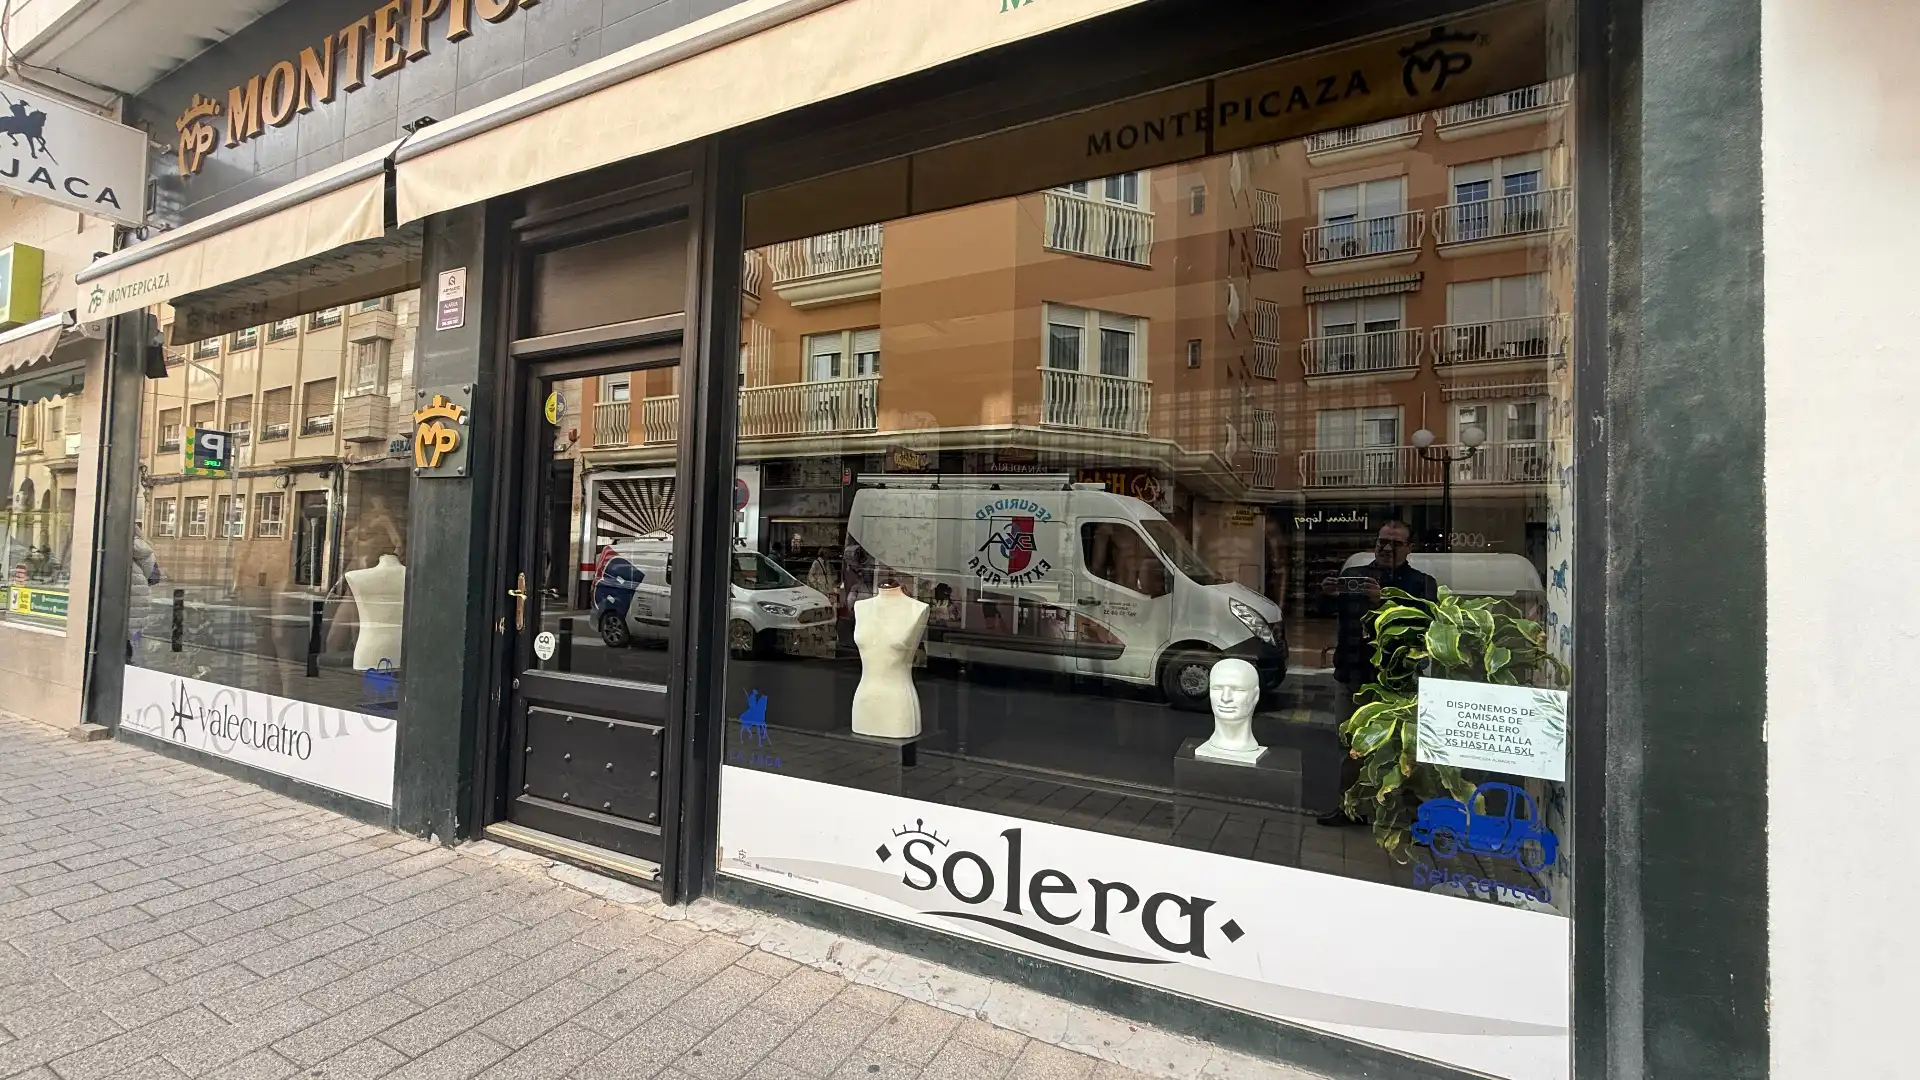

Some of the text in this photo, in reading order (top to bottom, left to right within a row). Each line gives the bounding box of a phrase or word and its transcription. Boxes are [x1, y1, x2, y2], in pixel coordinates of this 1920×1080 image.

[1086, 69, 1371, 157] MONTEPICAZA
[0, 158, 121, 210] JACA
[107, 273, 170, 304] MONTEPICAZA
[1446, 700, 1536, 717] DISPONEMOS DE
[1457, 711, 1524, 725] CAMISAS DE
[198, 704, 312, 761] valecuatro
[1445, 728, 1532, 746] DESDE LA TALLA
[1457, 720, 1520, 735] CABALLERO
[1445, 738, 1535, 757] XS HASTA LA 5XL
[902, 828, 1217, 960] solera
